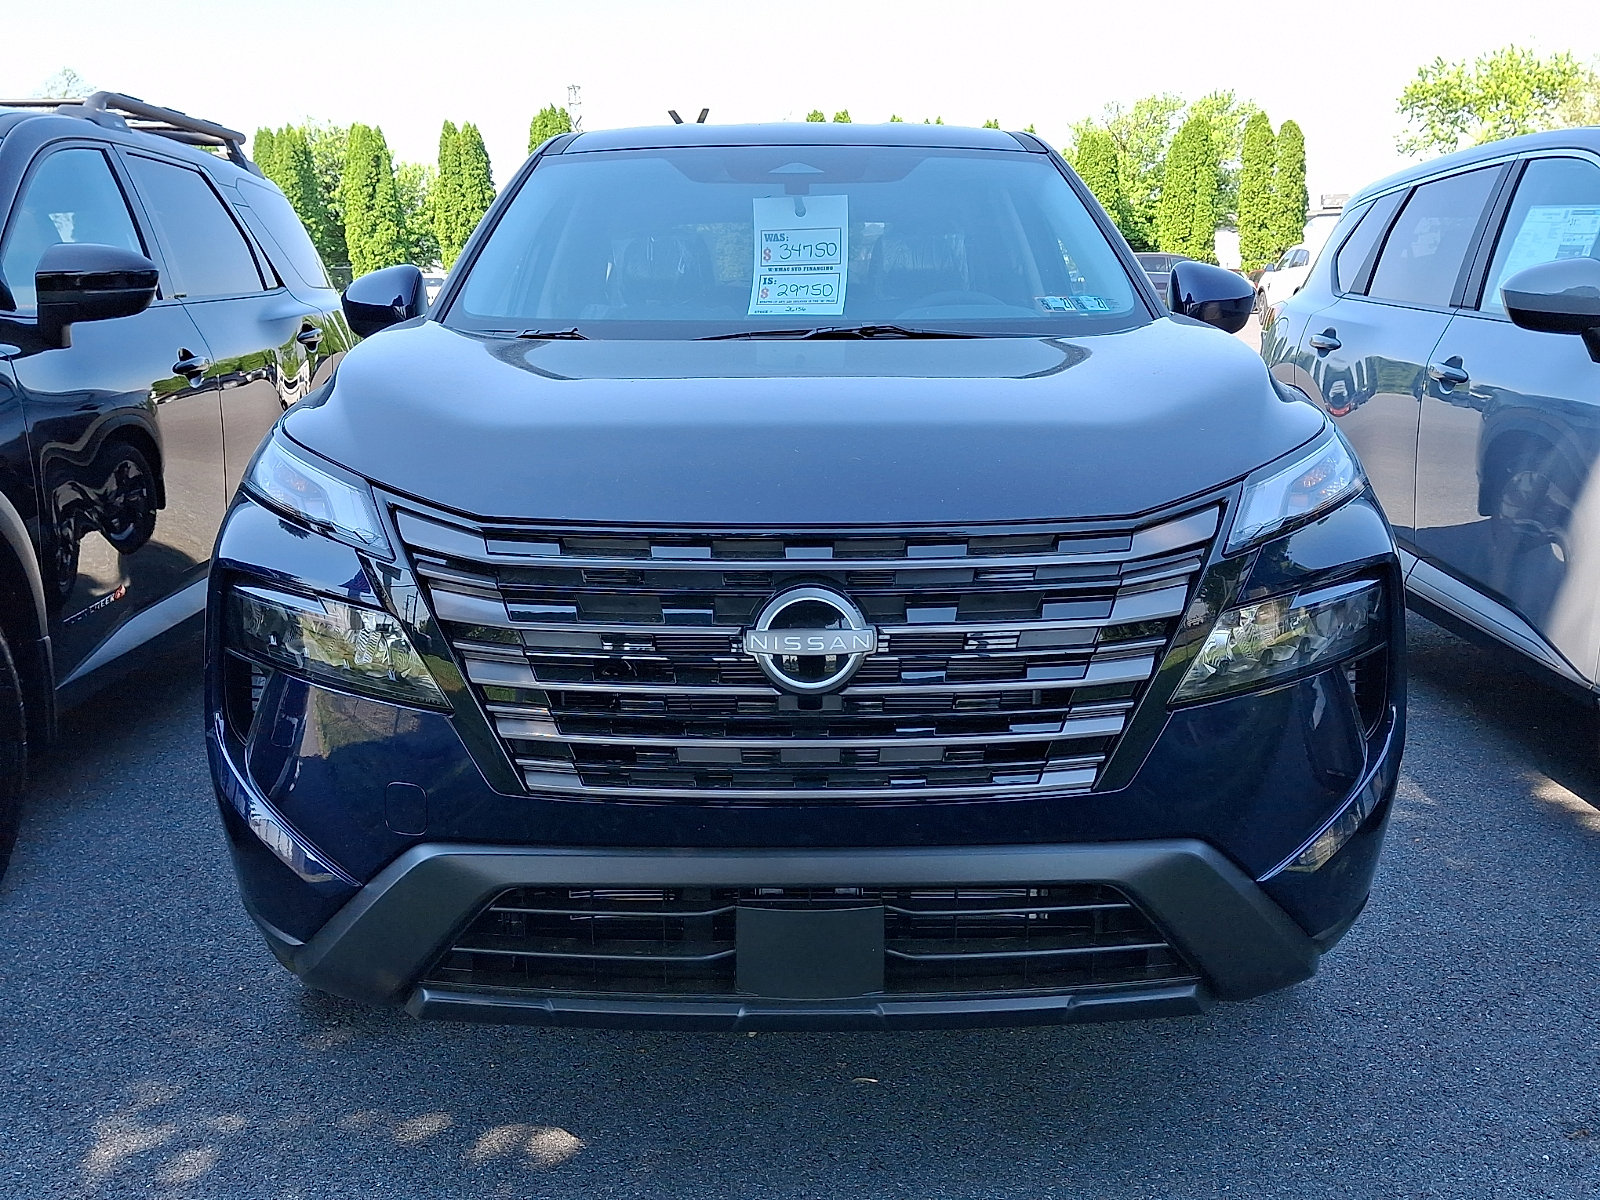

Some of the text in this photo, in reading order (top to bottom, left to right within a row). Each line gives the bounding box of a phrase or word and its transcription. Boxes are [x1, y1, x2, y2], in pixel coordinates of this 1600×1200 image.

[764, 233, 789, 242] WAS:
[763, 241, 837, 262] $ 34750
[763, 277, 777, 285] IS:
[760, 283, 834, 299] $ 29750
[750, 635, 870, 651] NISSAN
